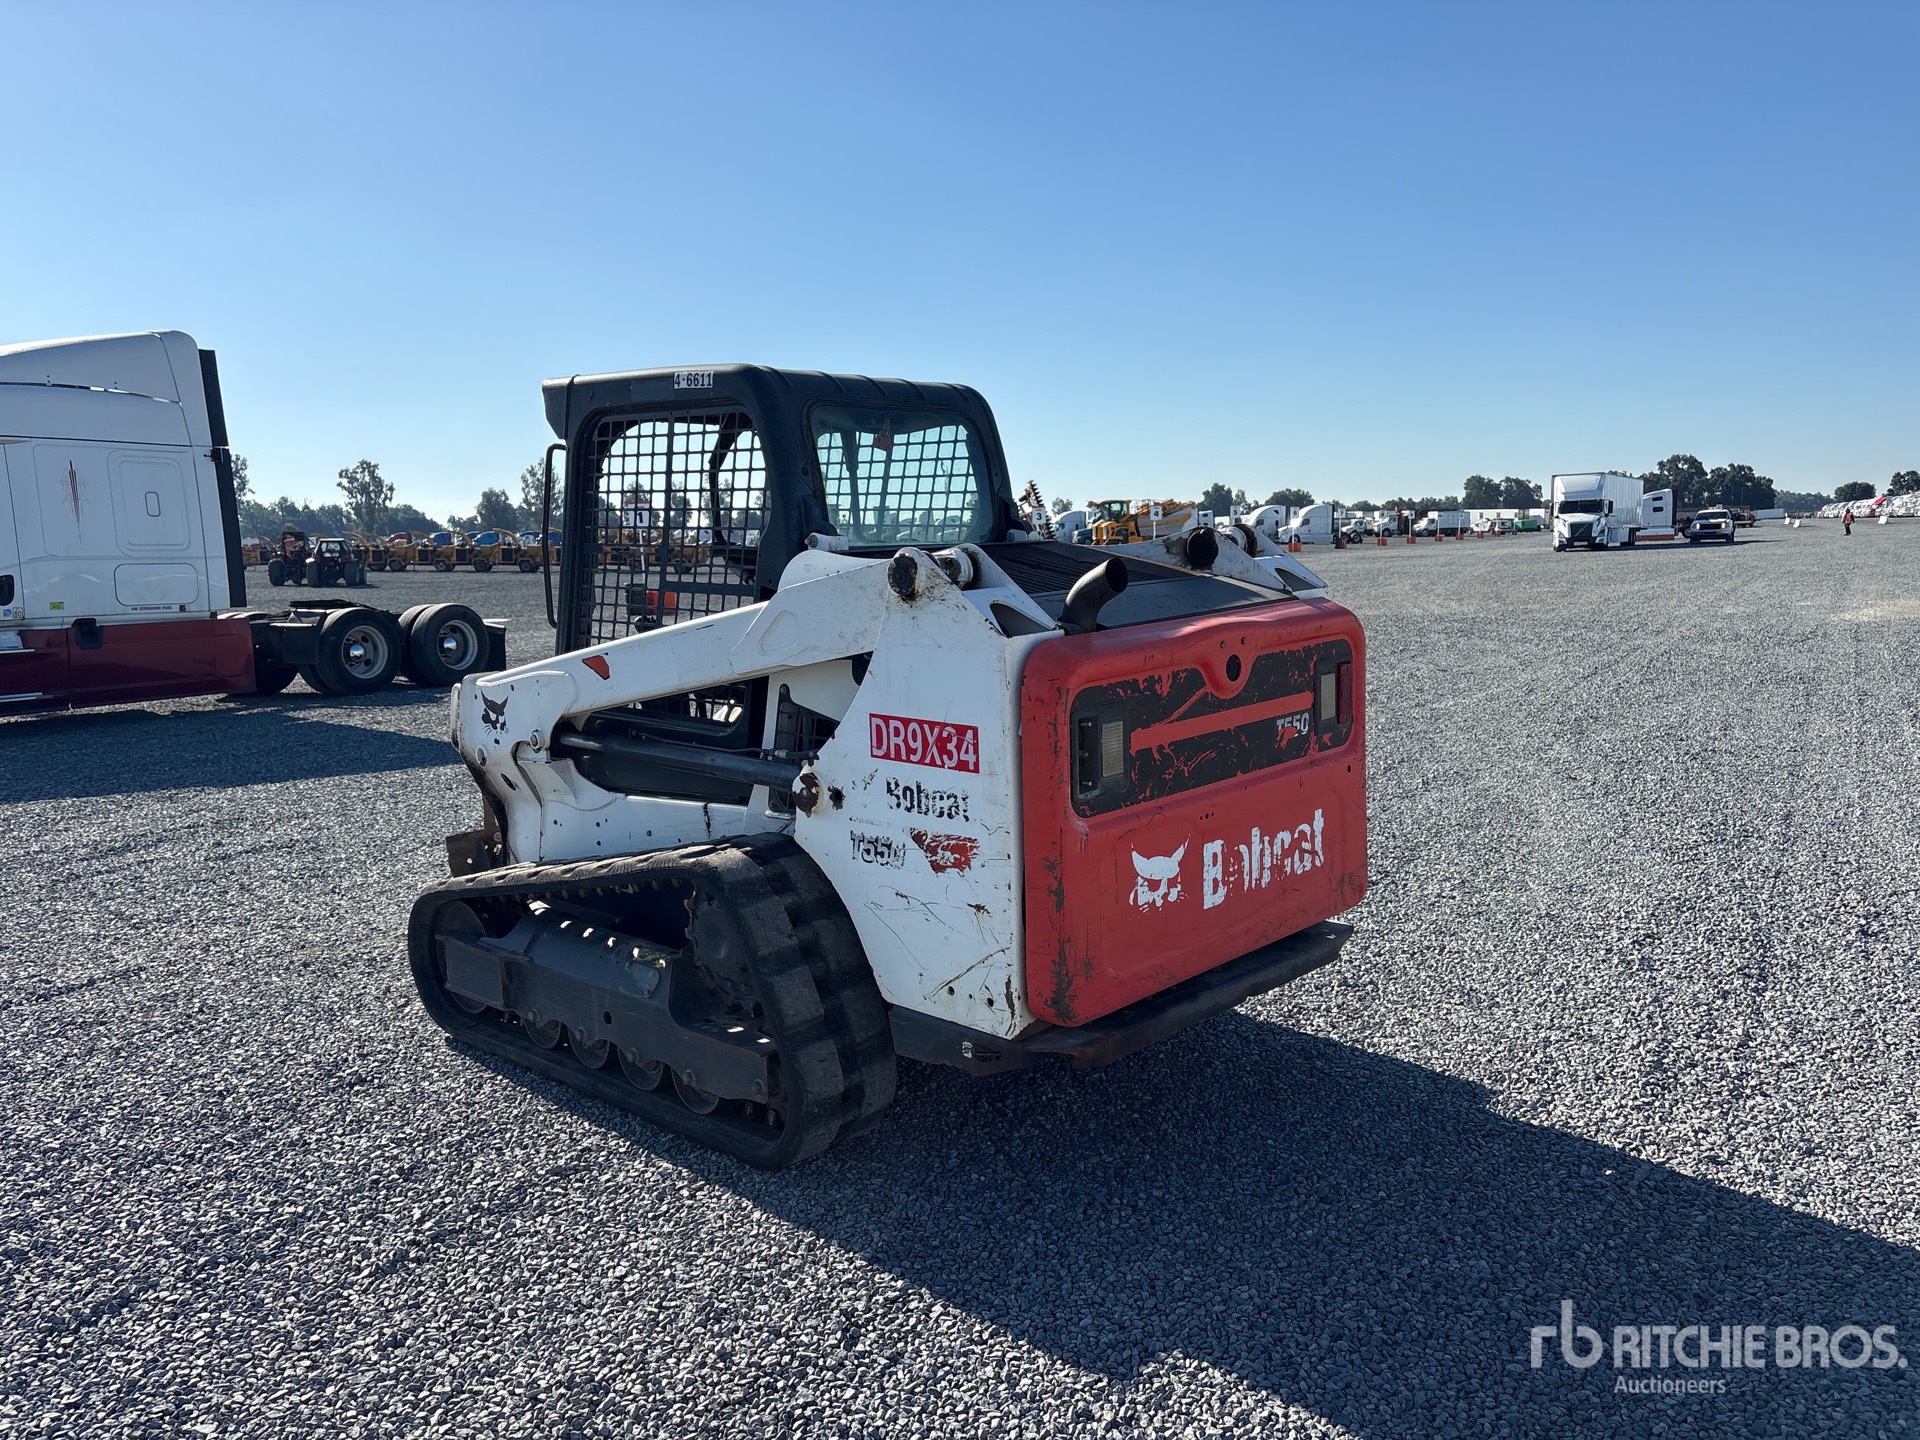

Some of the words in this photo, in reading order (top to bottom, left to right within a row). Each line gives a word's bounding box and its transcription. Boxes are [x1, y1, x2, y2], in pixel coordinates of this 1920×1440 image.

[674, 372, 712, 388] 4-6611
[1036, 512, 1042, 521] 3
[1153, 510, 1159, 518] 4
[871, 717, 977, 770] DR9X34
